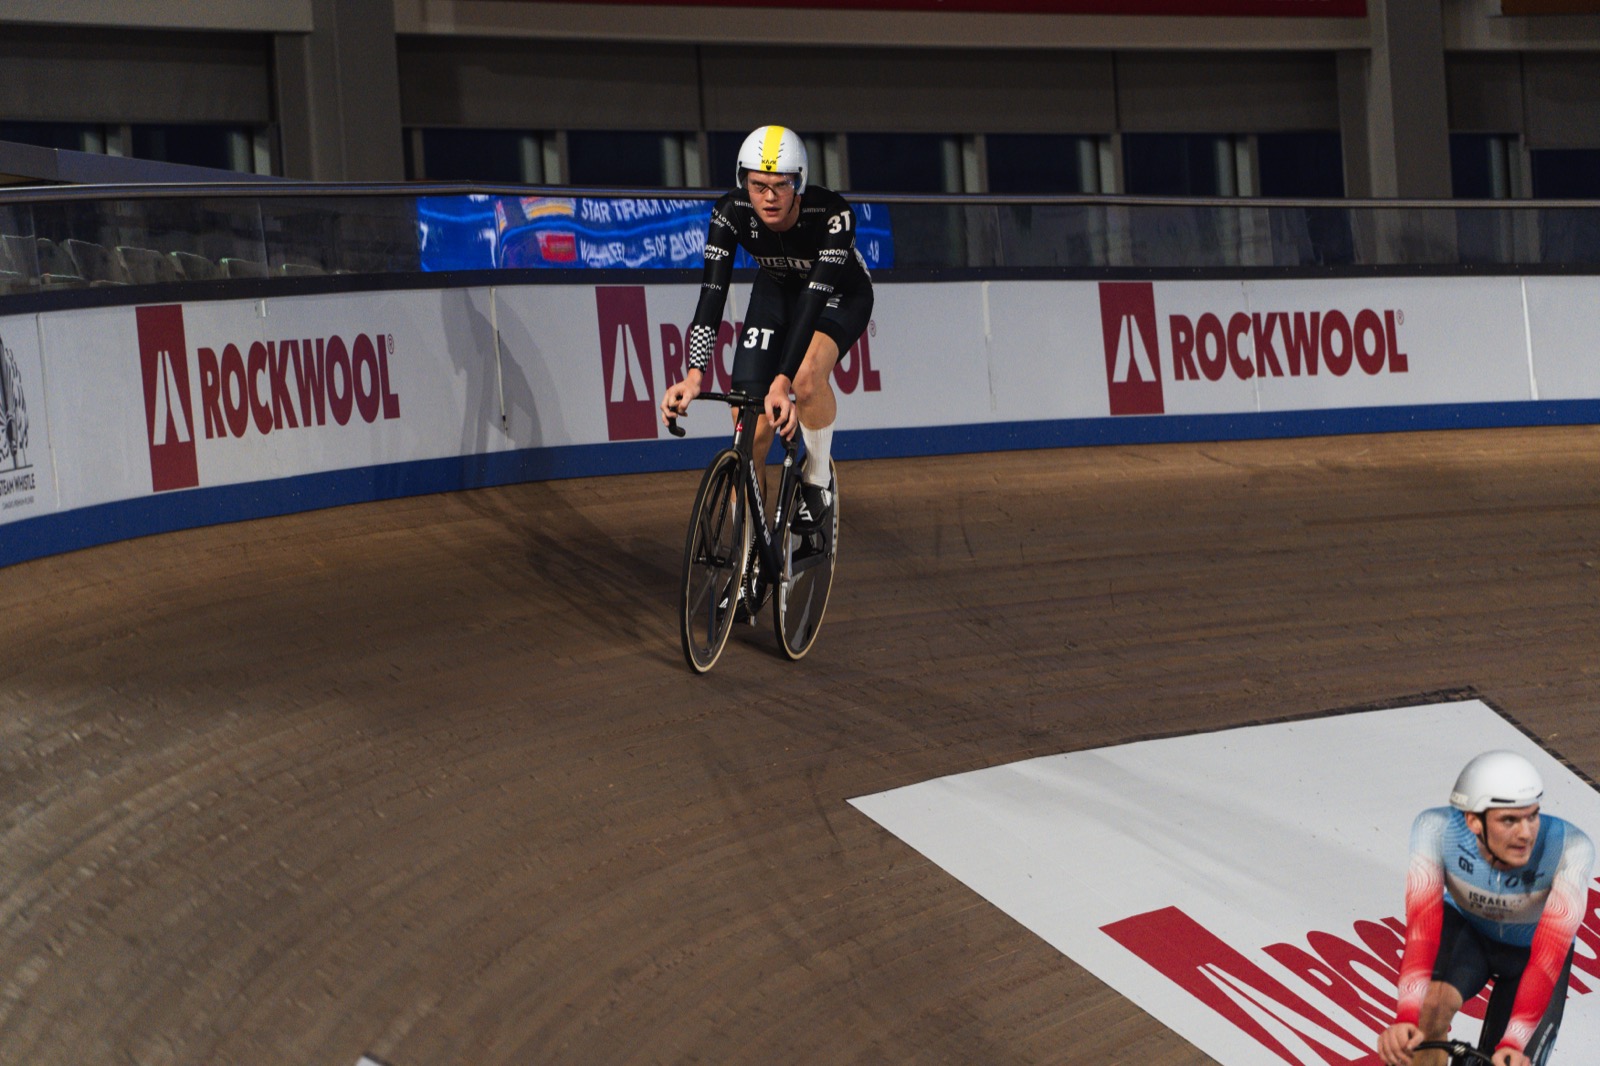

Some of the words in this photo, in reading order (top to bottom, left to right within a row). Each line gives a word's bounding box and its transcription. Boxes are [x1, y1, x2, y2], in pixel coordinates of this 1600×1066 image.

[581, 199, 612, 223] STAR
[827, 210, 851, 234] 3T
[743, 327, 775, 350] 3T
[1169, 309, 1408, 381] ROCKWOOL
[197, 333, 400, 438] ROCKWOOL
[1469, 890, 1507, 907] ISRAEL
